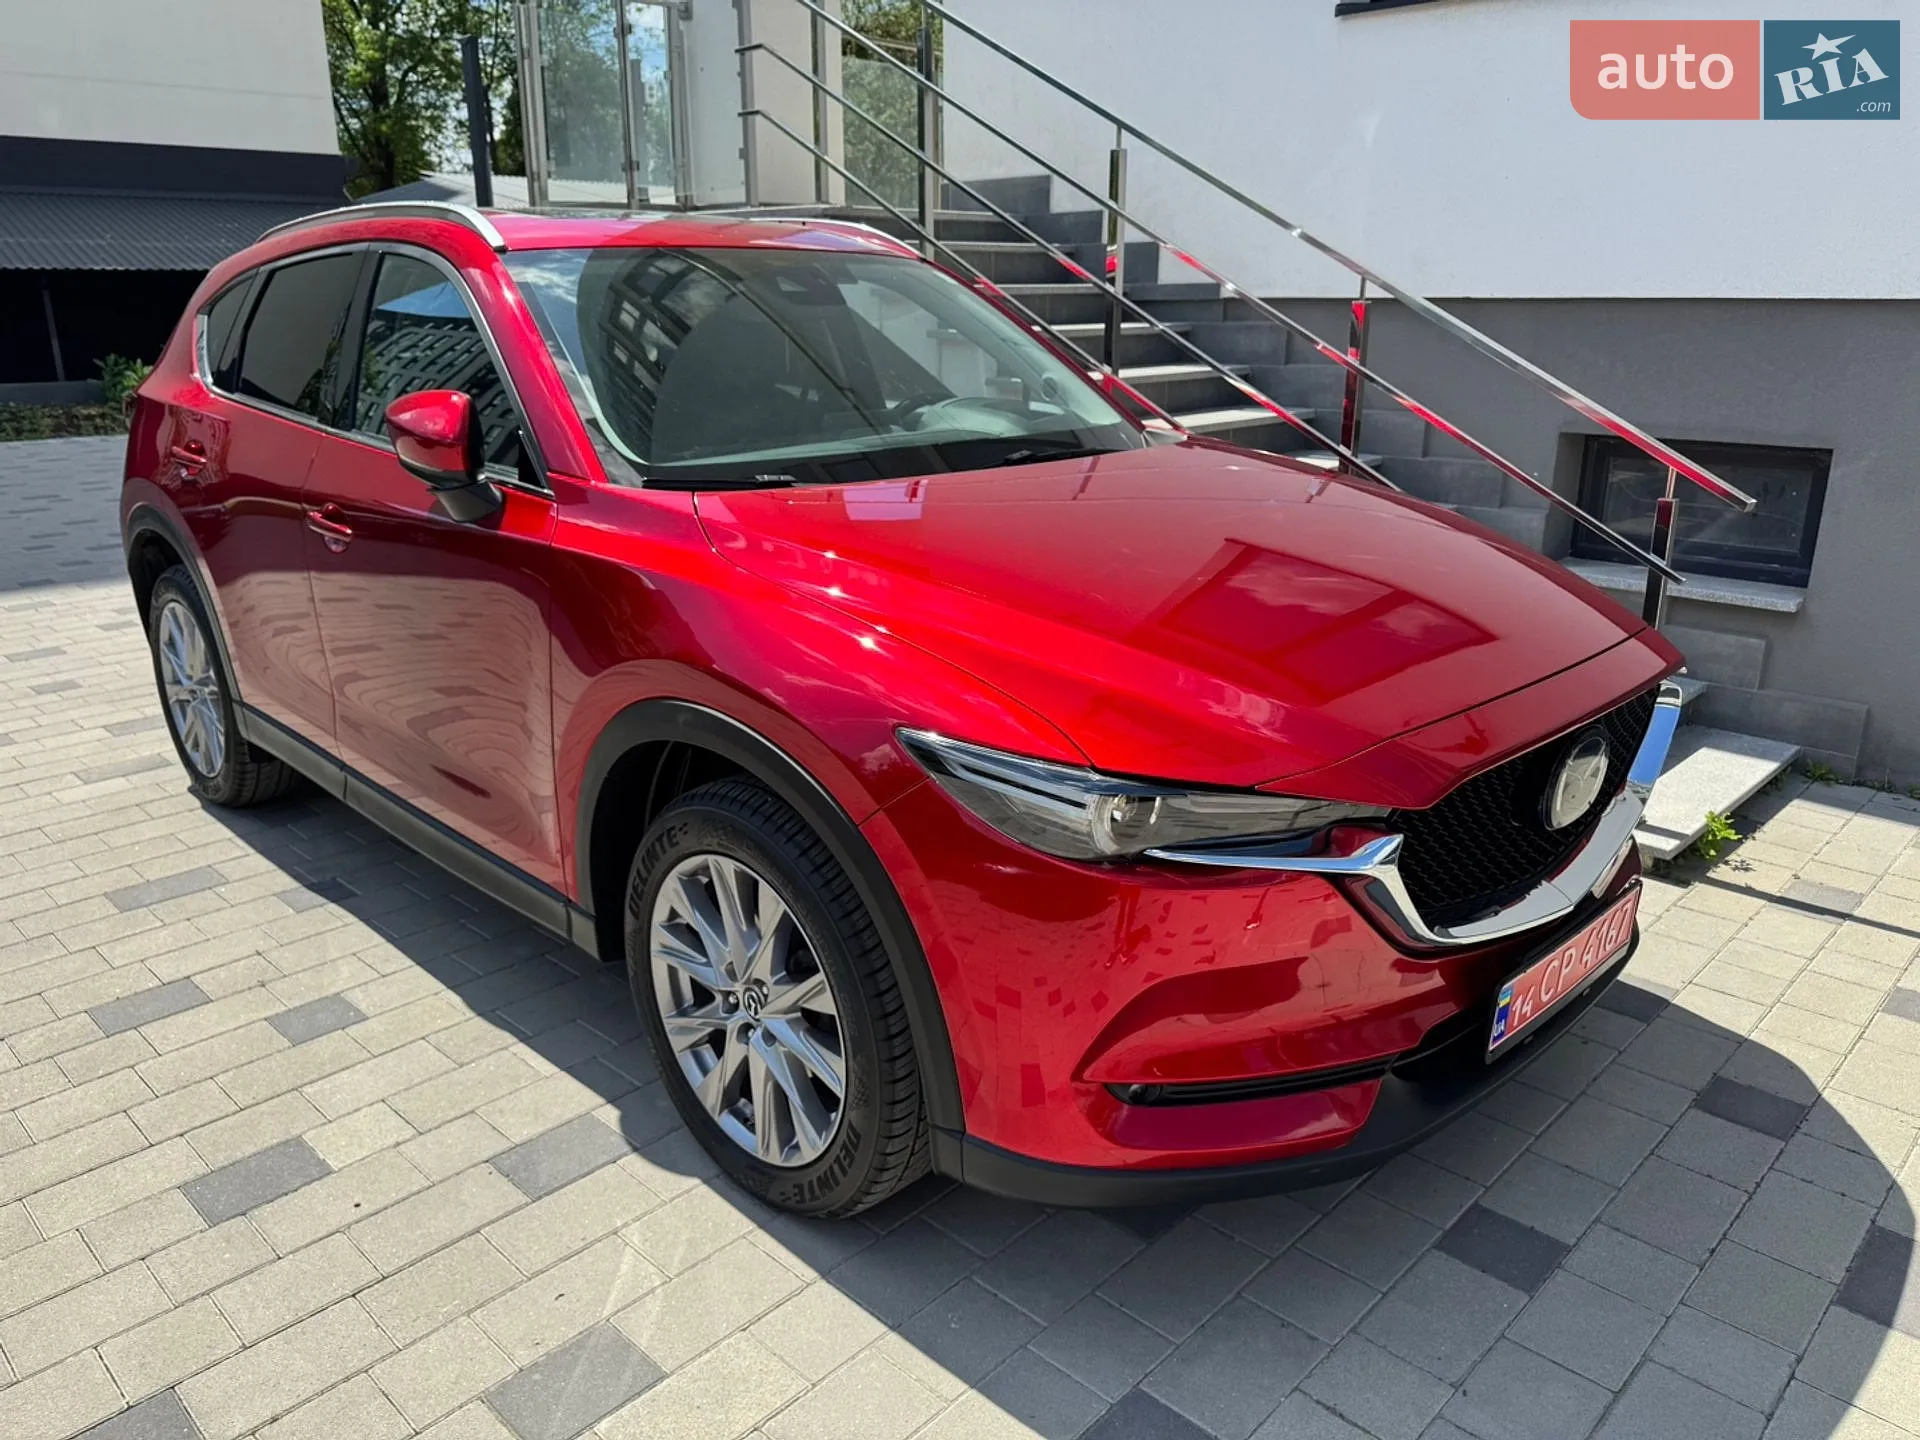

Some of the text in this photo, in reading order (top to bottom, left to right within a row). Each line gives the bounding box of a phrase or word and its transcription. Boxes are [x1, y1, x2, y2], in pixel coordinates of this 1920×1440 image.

[628, 824, 680, 921] DELINTE
[1512, 899, 1632, 1028] 14 CP 4167
[795, 1119, 863, 1204] DELINTE
